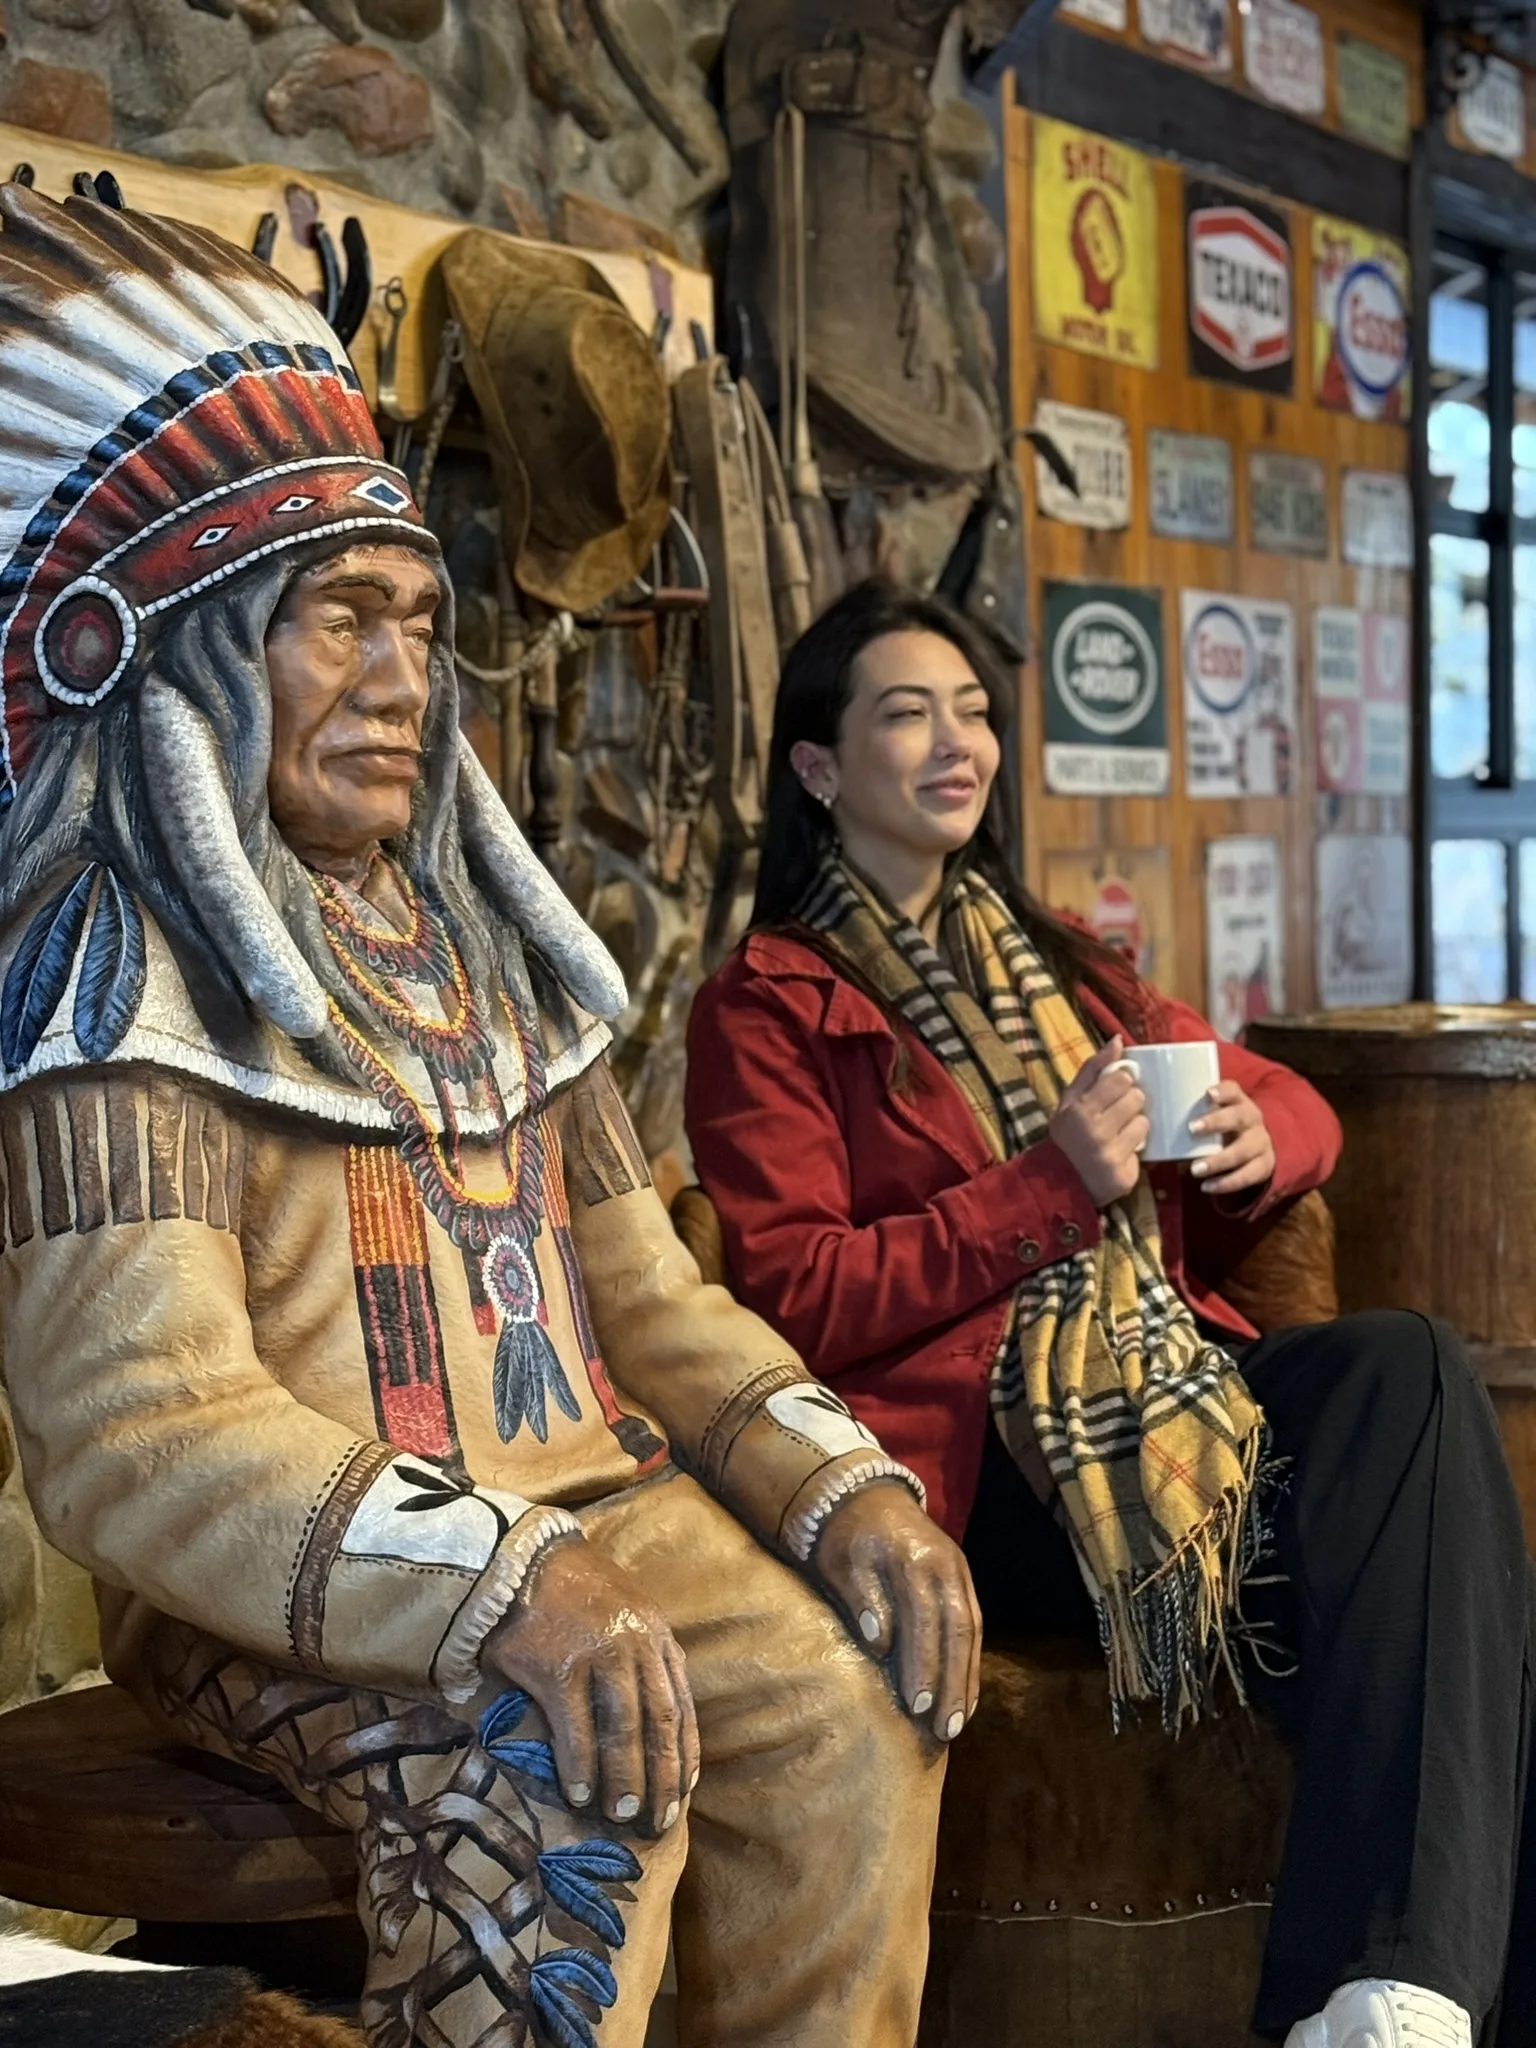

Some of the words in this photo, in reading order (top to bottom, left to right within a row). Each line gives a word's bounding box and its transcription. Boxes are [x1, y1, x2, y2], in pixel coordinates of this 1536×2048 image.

[1062, 138, 1132, 203] SHELL
[1201, 250, 1282, 320] TEXACO
[1198, 630, 1246, 680] Esso
